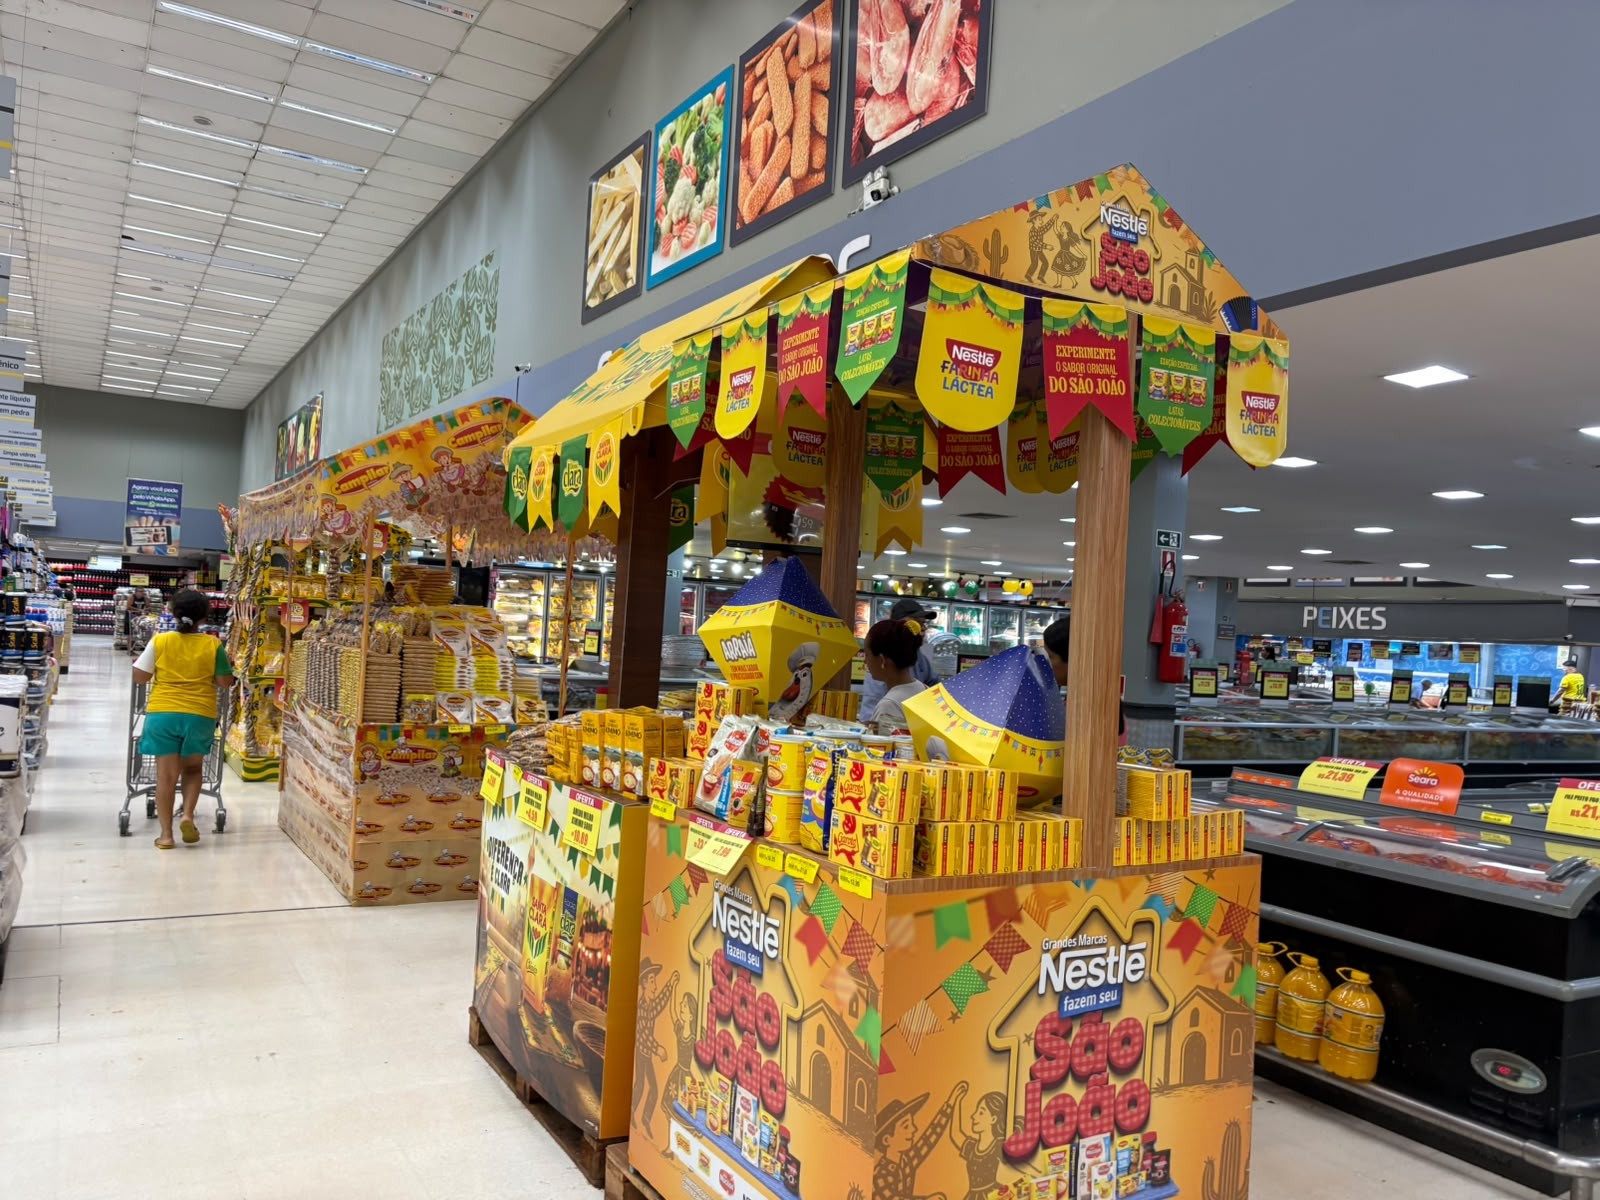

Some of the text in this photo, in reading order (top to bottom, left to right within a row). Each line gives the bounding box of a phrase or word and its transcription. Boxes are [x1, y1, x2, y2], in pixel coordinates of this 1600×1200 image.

[1101, 205, 1148, 236] Nestlé
[1111, 228, 1127, 238] fazem
[1100, 231, 1150, 275] São
[1090, 257, 1154, 304] João
[783, 326, 820, 351] EXPERIMENTE
[952, 344, 994, 367] Nestlé
[1056, 344, 1116, 361] EXPERIMENTE
[779, 353, 823, 386] DO SÃO JOÃO
[941, 360, 999, 385] FARINHA
[1055, 361, 1118, 376] O SABOR ORIGINAL
[943, 376, 994, 400] LÁCTEA
[1048, 373, 1126, 396] DO SÃO JOÃO
[10, 394, 31, 403] líquido
[726, 397, 750, 414] LÁCTEA
[1246, 394, 1275, 410] Nestlé
[11, 407, 30, 417] pedra
[1240, 409, 1279, 424] FARINHA
[792, 430, 823, 445] Nestlé
[1242, 423, 1277, 437] LÁCTEA
[788, 451, 823, 466] LÁCTEA
[940, 451, 1001, 467] DO SÃO JOÃO
[1019, 461, 1037, 472] LÁCT
[563, 462, 582, 488] clara
[1302, 605, 1387, 631] PEIXES
[383, 749, 438, 765] Campilar
[1329, 757, 1367, 767] OFERTA
[526, 774, 543, 787] OFERTA
[1408, 773, 1439, 786] Seara
[575, 793, 595, 807] OFERTA
[1402, 789, 1445, 803] QUALIDADE
[1570, 808, 1580, 818] R$
[495, 867, 511, 896] CLARA
[714, 878, 753, 905] Grandes Marcas
[532, 896, 547, 915] SANTA
[528, 907, 547, 931] CLARA
[560, 913, 576, 936] clara
[712, 891, 780, 959] Nestlé
[1042, 934, 1108, 950] Grandes Marcas
[726, 940, 760, 968] fazem seu
[1038, 942, 1147, 995] Nestlé
[710, 948, 781, 1047] São
[1063, 989, 1118, 1012] fazem seu
[1030, 1010, 1145, 1084] São
[695, 1002, 786, 1116] João
[1002, 1072, 1151, 1158] João
